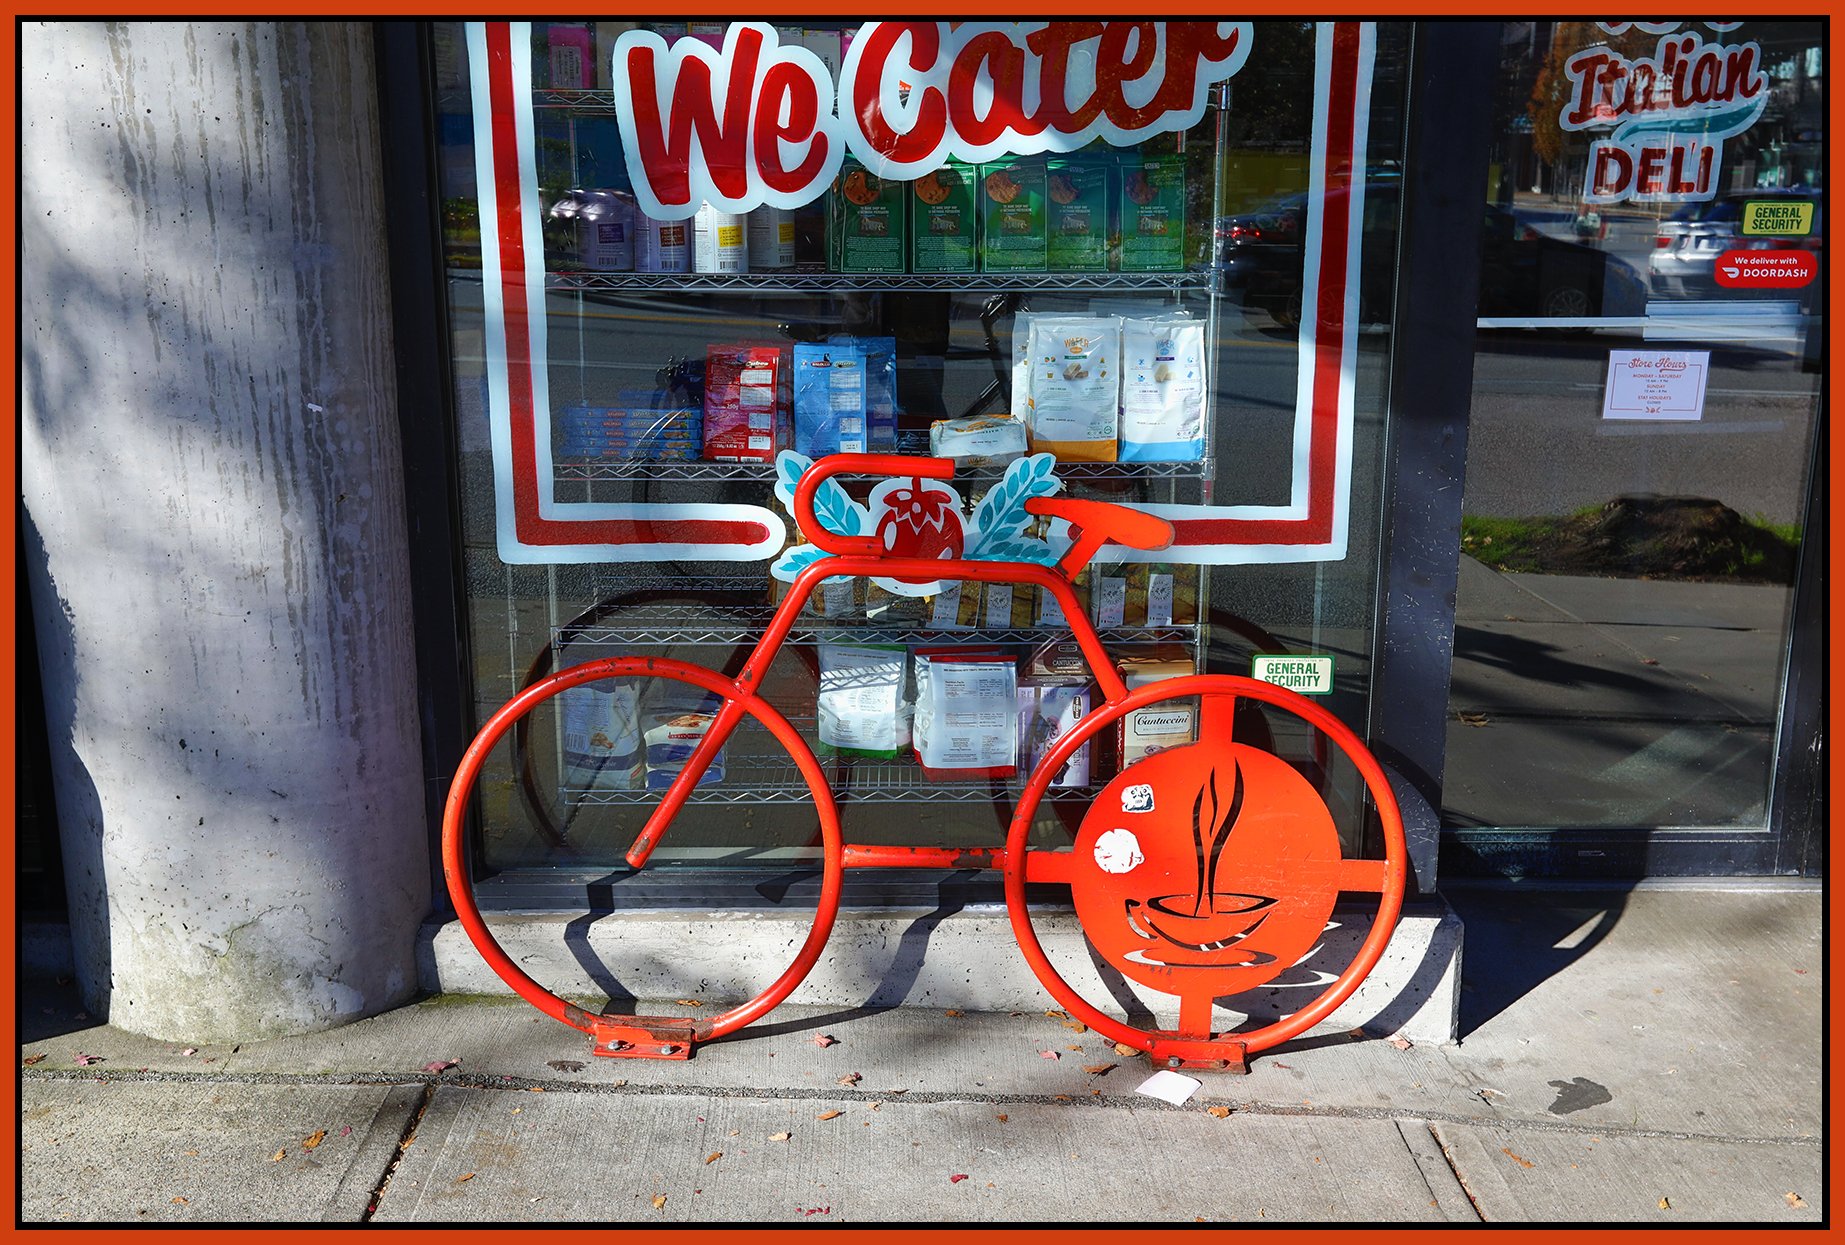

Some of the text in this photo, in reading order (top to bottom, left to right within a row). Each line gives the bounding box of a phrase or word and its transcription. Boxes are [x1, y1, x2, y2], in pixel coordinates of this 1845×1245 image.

[1567, 37, 1763, 125] Italian
[627, 22, 1240, 207] We Cater
[1593, 145, 1714, 196] DELI
[1755, 207, 1802, 218] GENERAL
[1752, 219, 1803, 230] SECURITY
[1734, 256, 1798, 265] We deliver with
[1743, 268, 1808, 278] DOORDASH
[1628, 357, 1687, 373] Store Hours
[1266, 662, 1319, 674] GENERAL
[1264, 675, 1321, 687] SECURITY
[1137, 714, 1190, 726] Cantuccini
